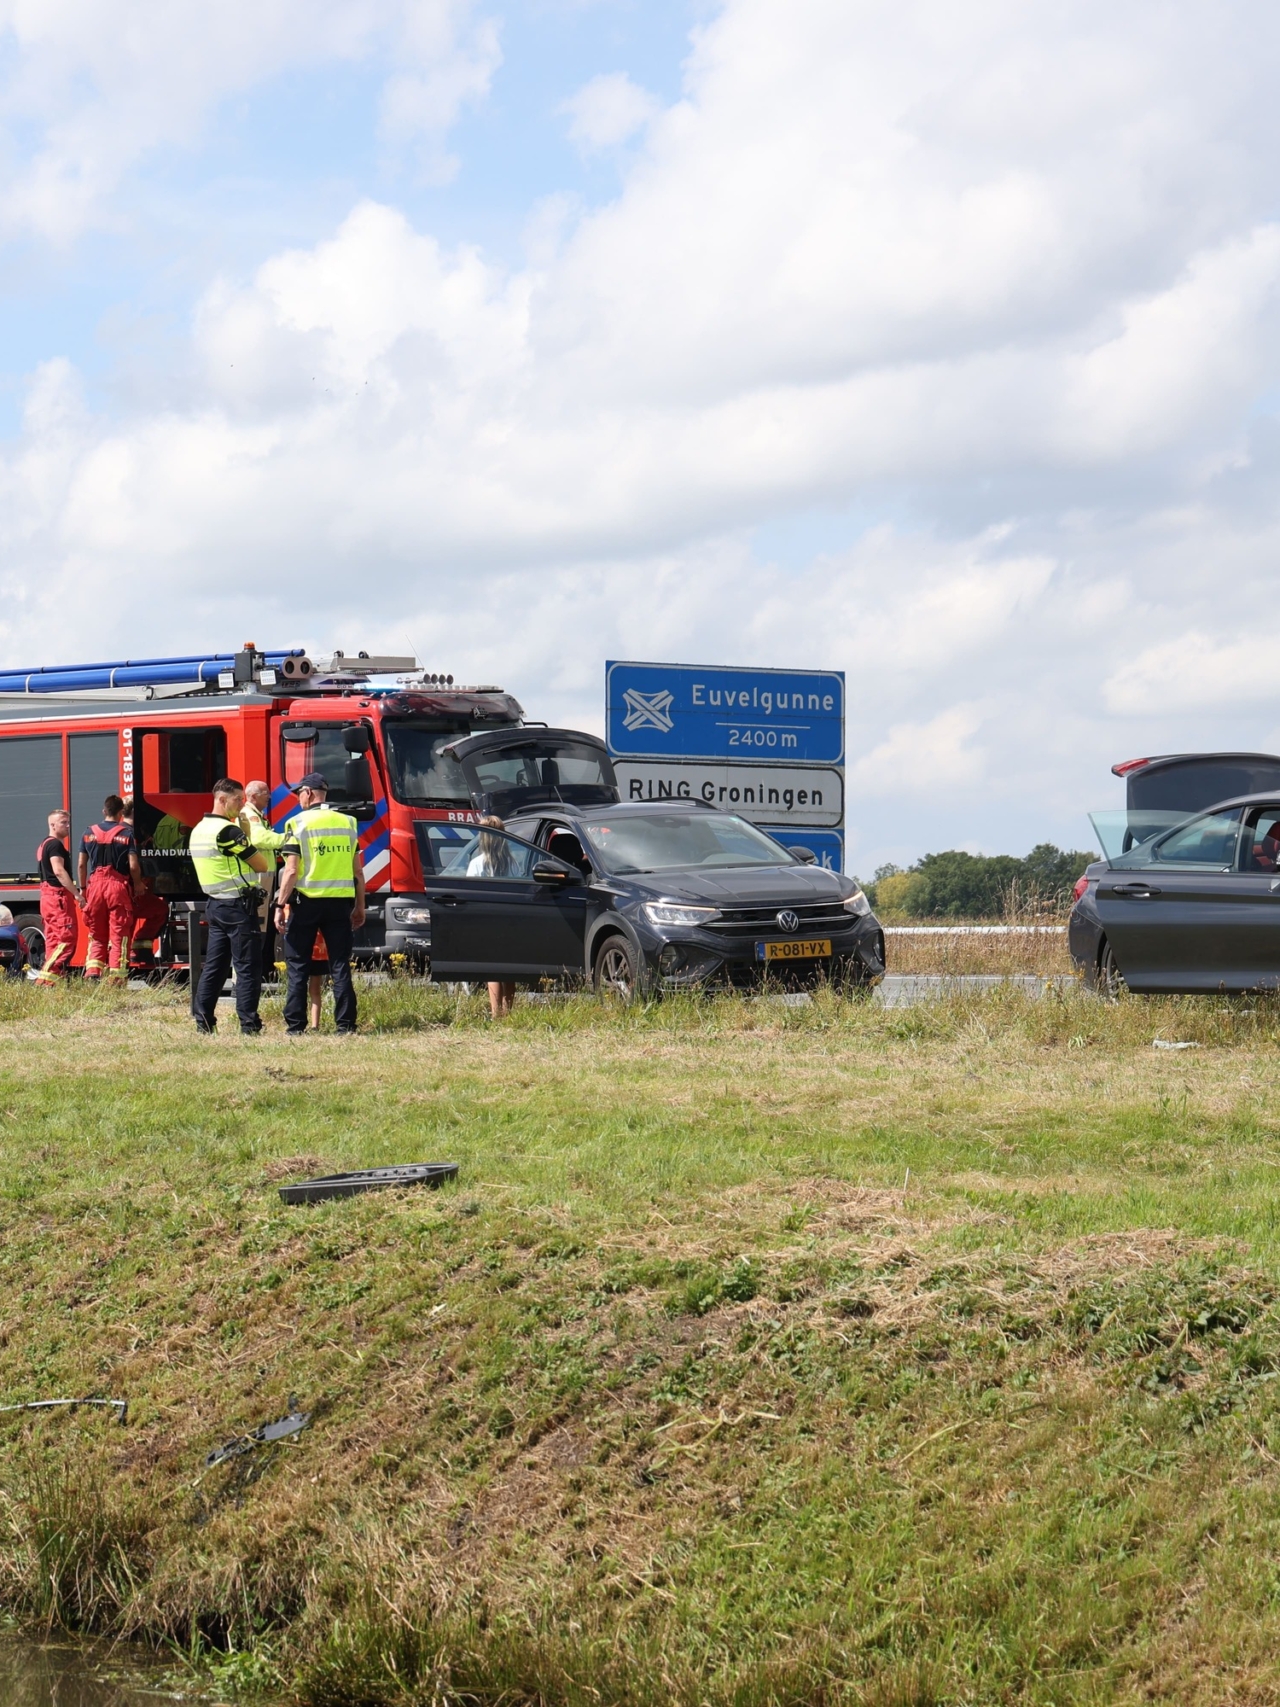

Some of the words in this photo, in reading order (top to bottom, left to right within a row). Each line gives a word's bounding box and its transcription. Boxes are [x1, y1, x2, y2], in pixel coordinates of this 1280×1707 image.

[692, 684, 834, 714] Euvelgunne
[729, 729, 777, 747] 2400
[781, 733, 798, 748] m
[629, 779, 691, 799] RING
[701, 781, 823, 811] Groningen
[770, 942, 826, 957] R-081-VX
